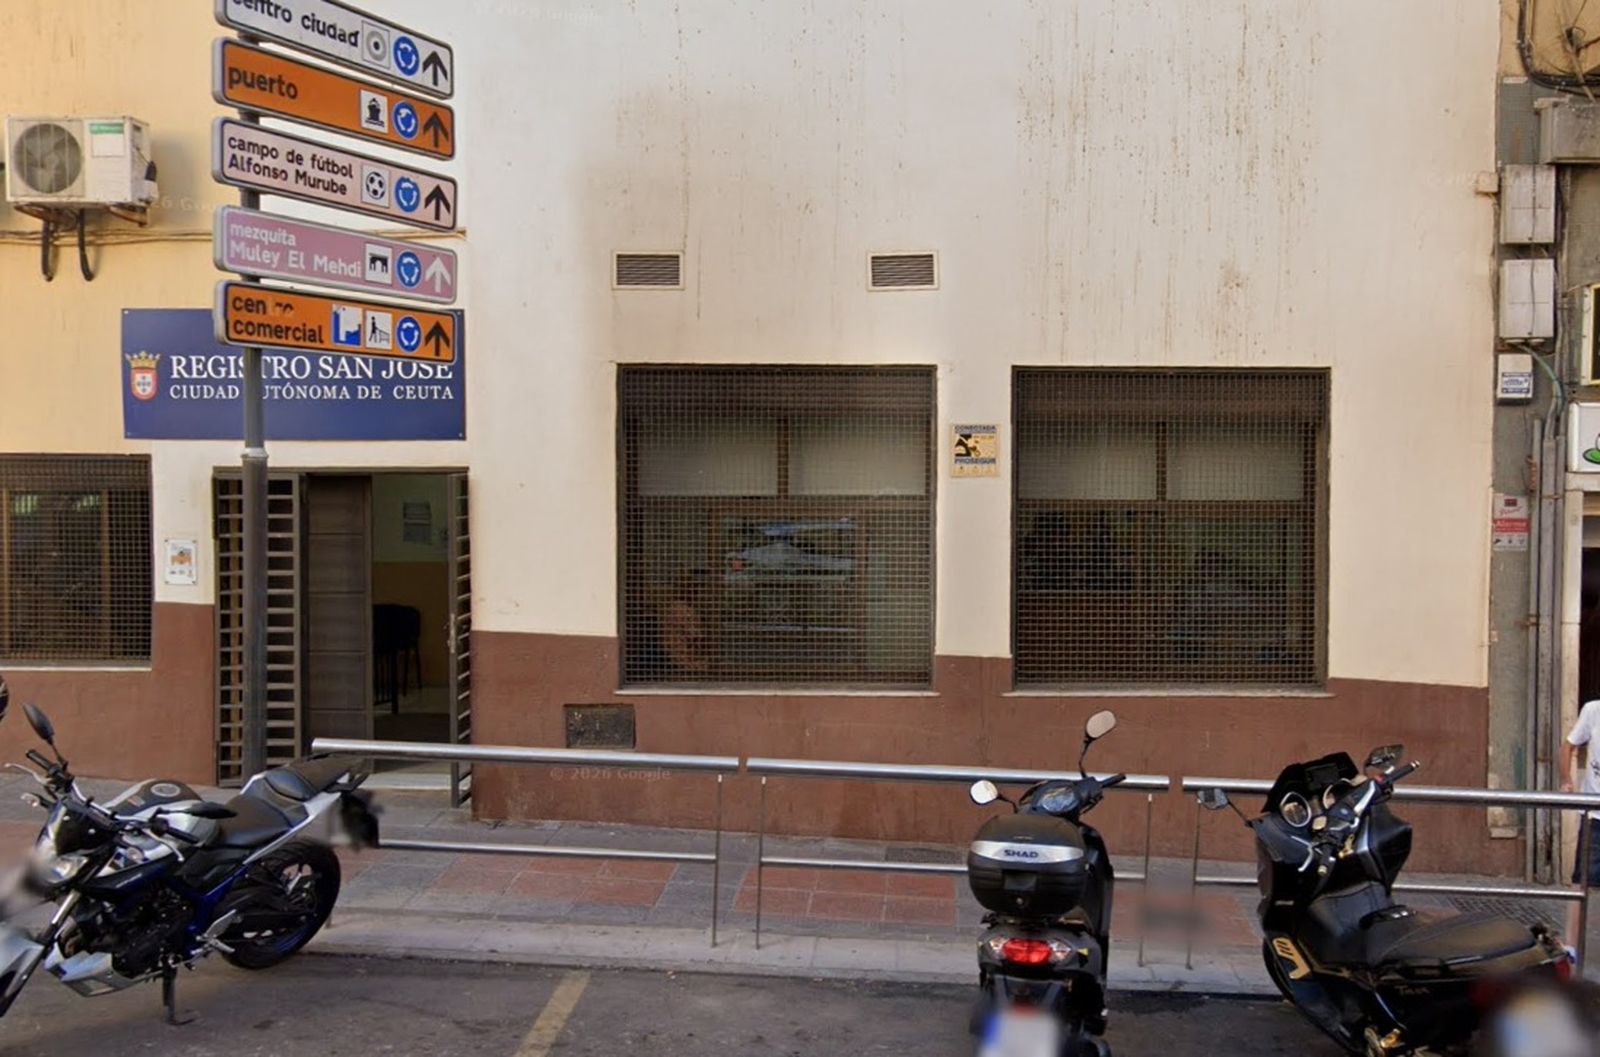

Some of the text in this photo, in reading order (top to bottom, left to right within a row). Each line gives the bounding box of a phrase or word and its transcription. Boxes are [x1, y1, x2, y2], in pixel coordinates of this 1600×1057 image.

[301, 13, 360, 47] ciudad
[228, 66, 298, 100] puerto
[228, 136, 354, 179] campo de fútbol
[228, 154, 347, 196] Alfonso Murube
[230, 223, 296, 249] mezquita
[229, 240, 362, 279] Muley El Mehdi
[233, 319, 323, 344] comercial
[318, 355, 373, 379] SAN
[169, 382, 454, 400] CIUDAD UTÓNOMA DE CEUTA
[1004, 849, 1038, 858] SHAD
